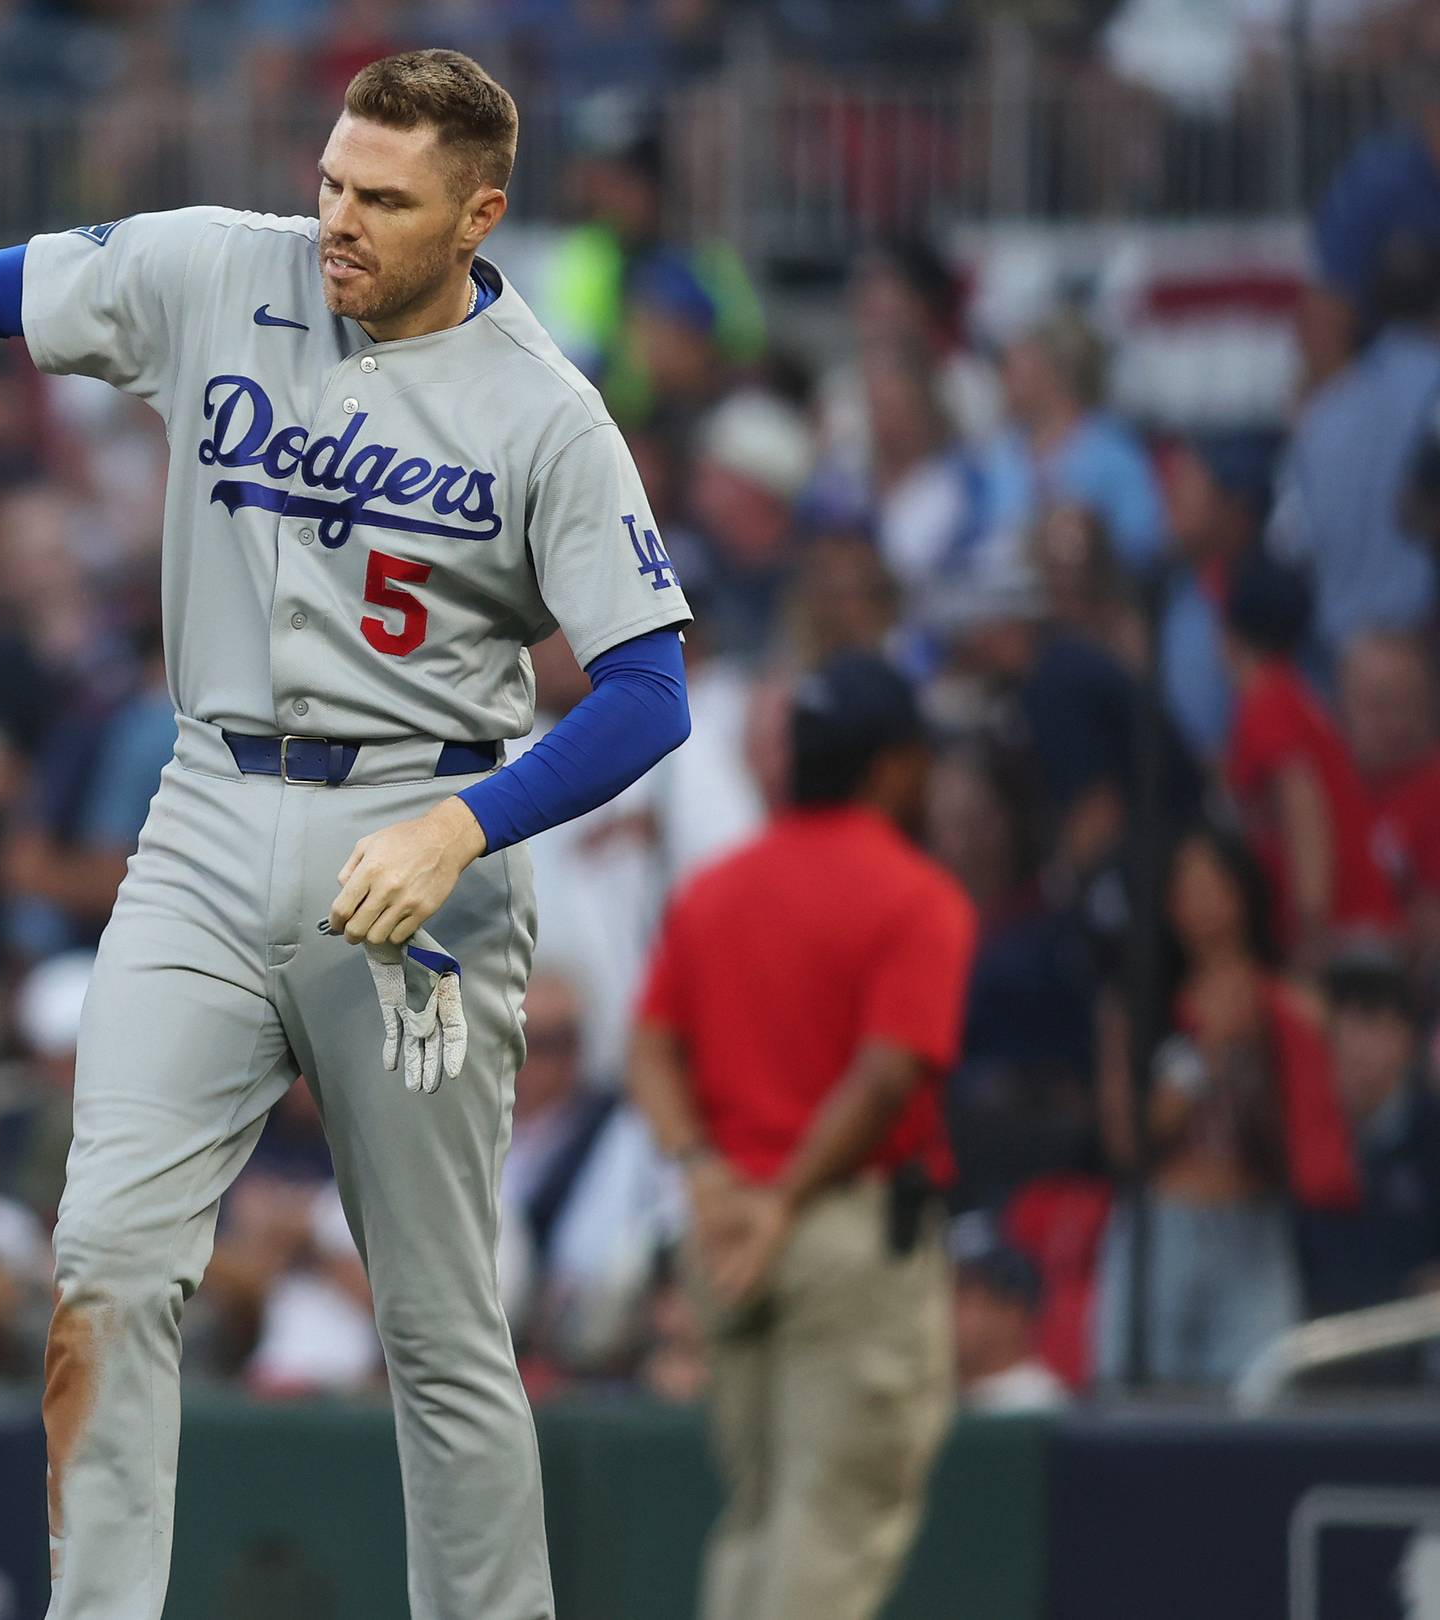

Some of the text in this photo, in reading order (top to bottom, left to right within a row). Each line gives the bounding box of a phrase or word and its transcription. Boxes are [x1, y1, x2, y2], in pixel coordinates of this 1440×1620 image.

[199, 375, 503, 549] Dodgers
[360, 549, 433, 657] 5
[620, 514, 681, 591] LA
